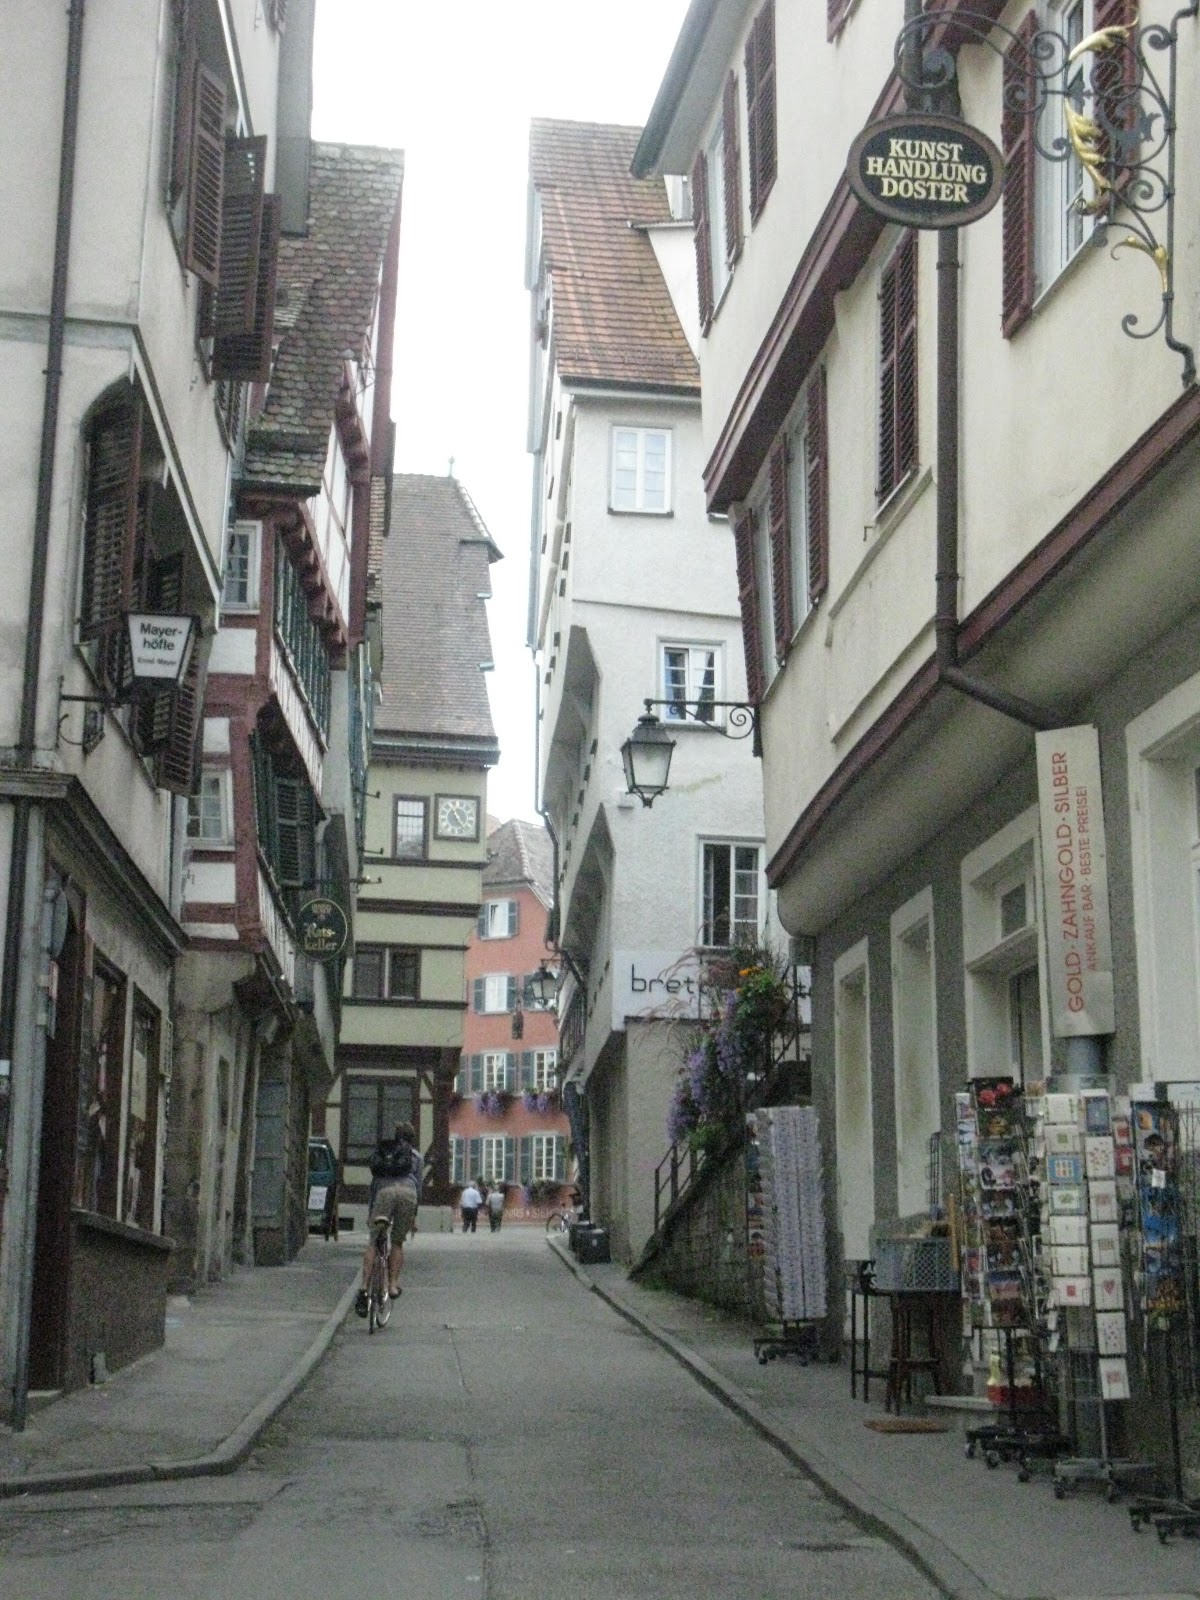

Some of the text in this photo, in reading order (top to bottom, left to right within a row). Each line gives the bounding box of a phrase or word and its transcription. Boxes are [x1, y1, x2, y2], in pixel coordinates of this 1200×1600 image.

[889, 139, 963, 162] KUNST
[866, 156, 987, 184] HANDLUNG
[881, 177, 969, 203] DOSTER
[140, 622, 182, 638] Mayer-
[143, 637, 175, 650] höfle
[1052, 752, 1084, 1012] GOLD ZAHNGOLD SILBER
[1076, 786, 1097, 971] ANKAUF BAR BESTE PREISE!
